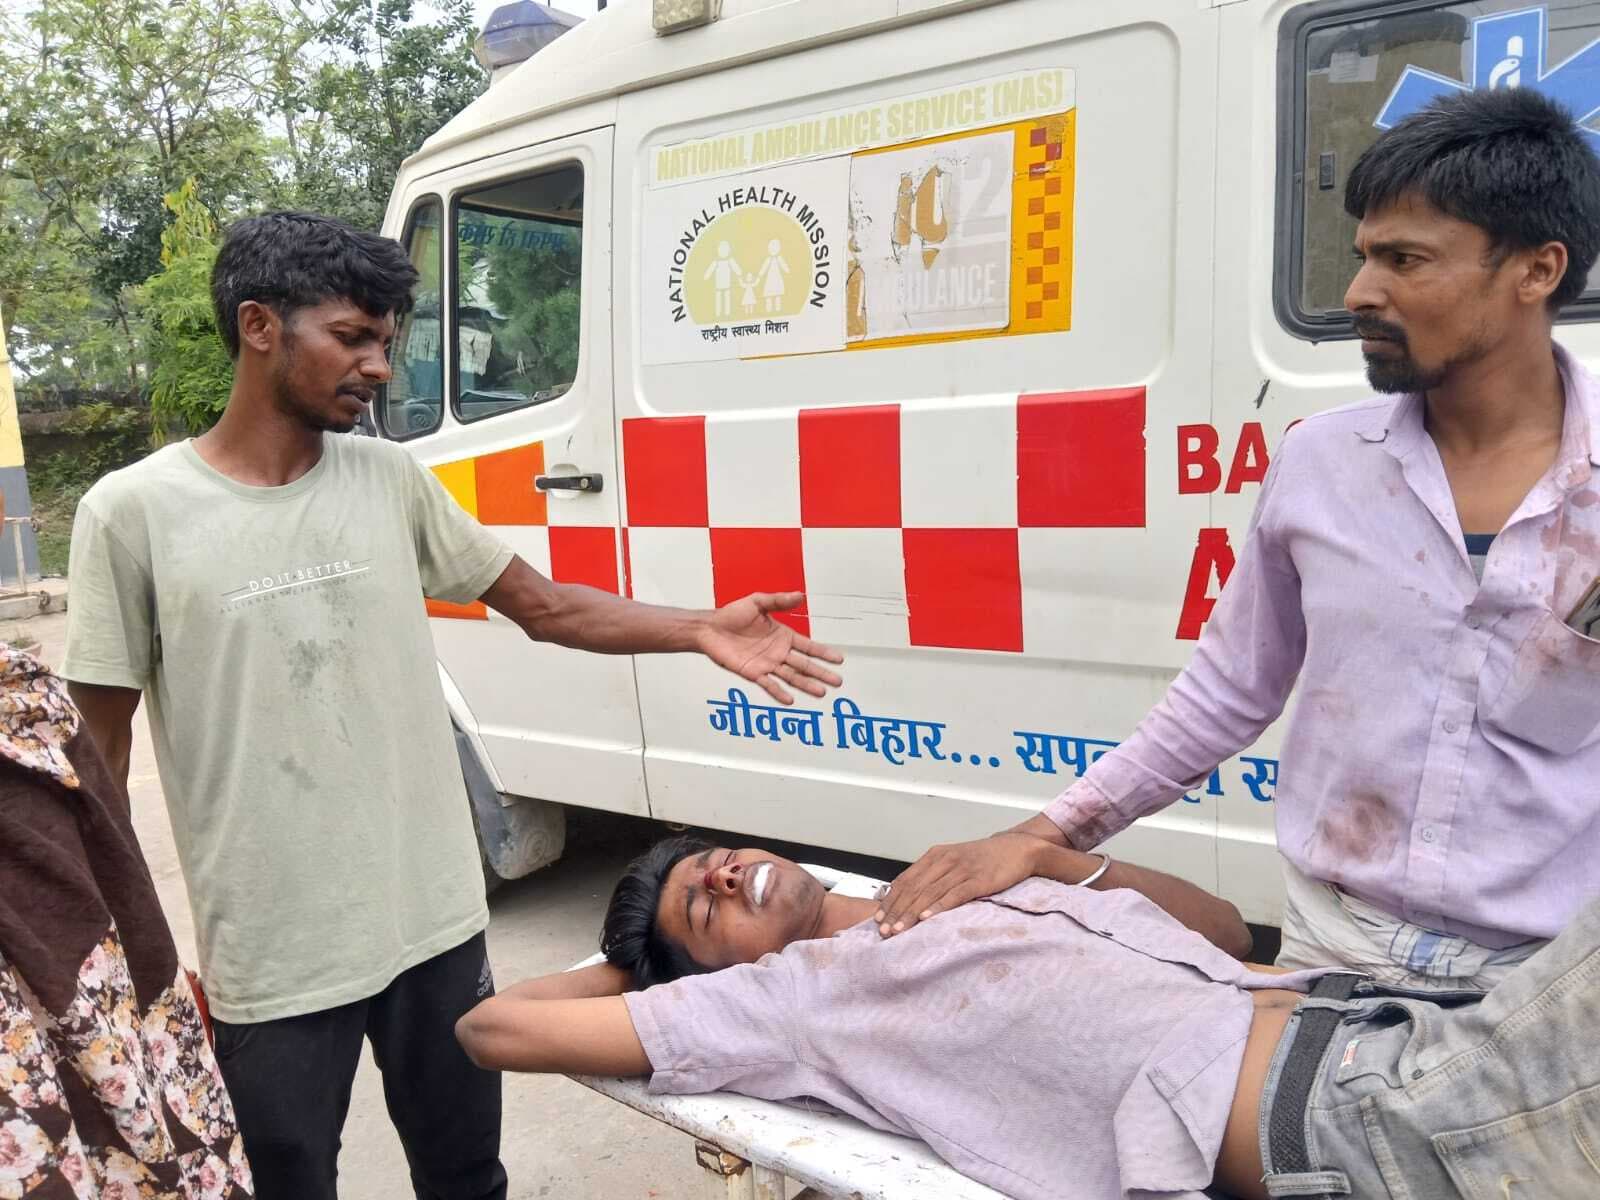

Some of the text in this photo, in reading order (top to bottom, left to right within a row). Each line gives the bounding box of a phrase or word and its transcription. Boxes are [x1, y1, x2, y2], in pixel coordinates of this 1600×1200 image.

[656, 135, 748, 181] NATIONAL
[752, 107, 880, 163] AMBULANCE
[887, 87, 986, 137] SERVICE
[668, 186, 830, 323] NATIONAL HEALTH MISSION
[701, 319, 789, 342] राष्ट्रीय स्वास्थ्य मिशन
[1177, 420, 1274, 495] BA
[249, 576, 273, 592] DO
[278, 572, 291, 584] IT
[297, 560, 352, 580] BETTER
[706, 687, 824, 747] जीवन्त
